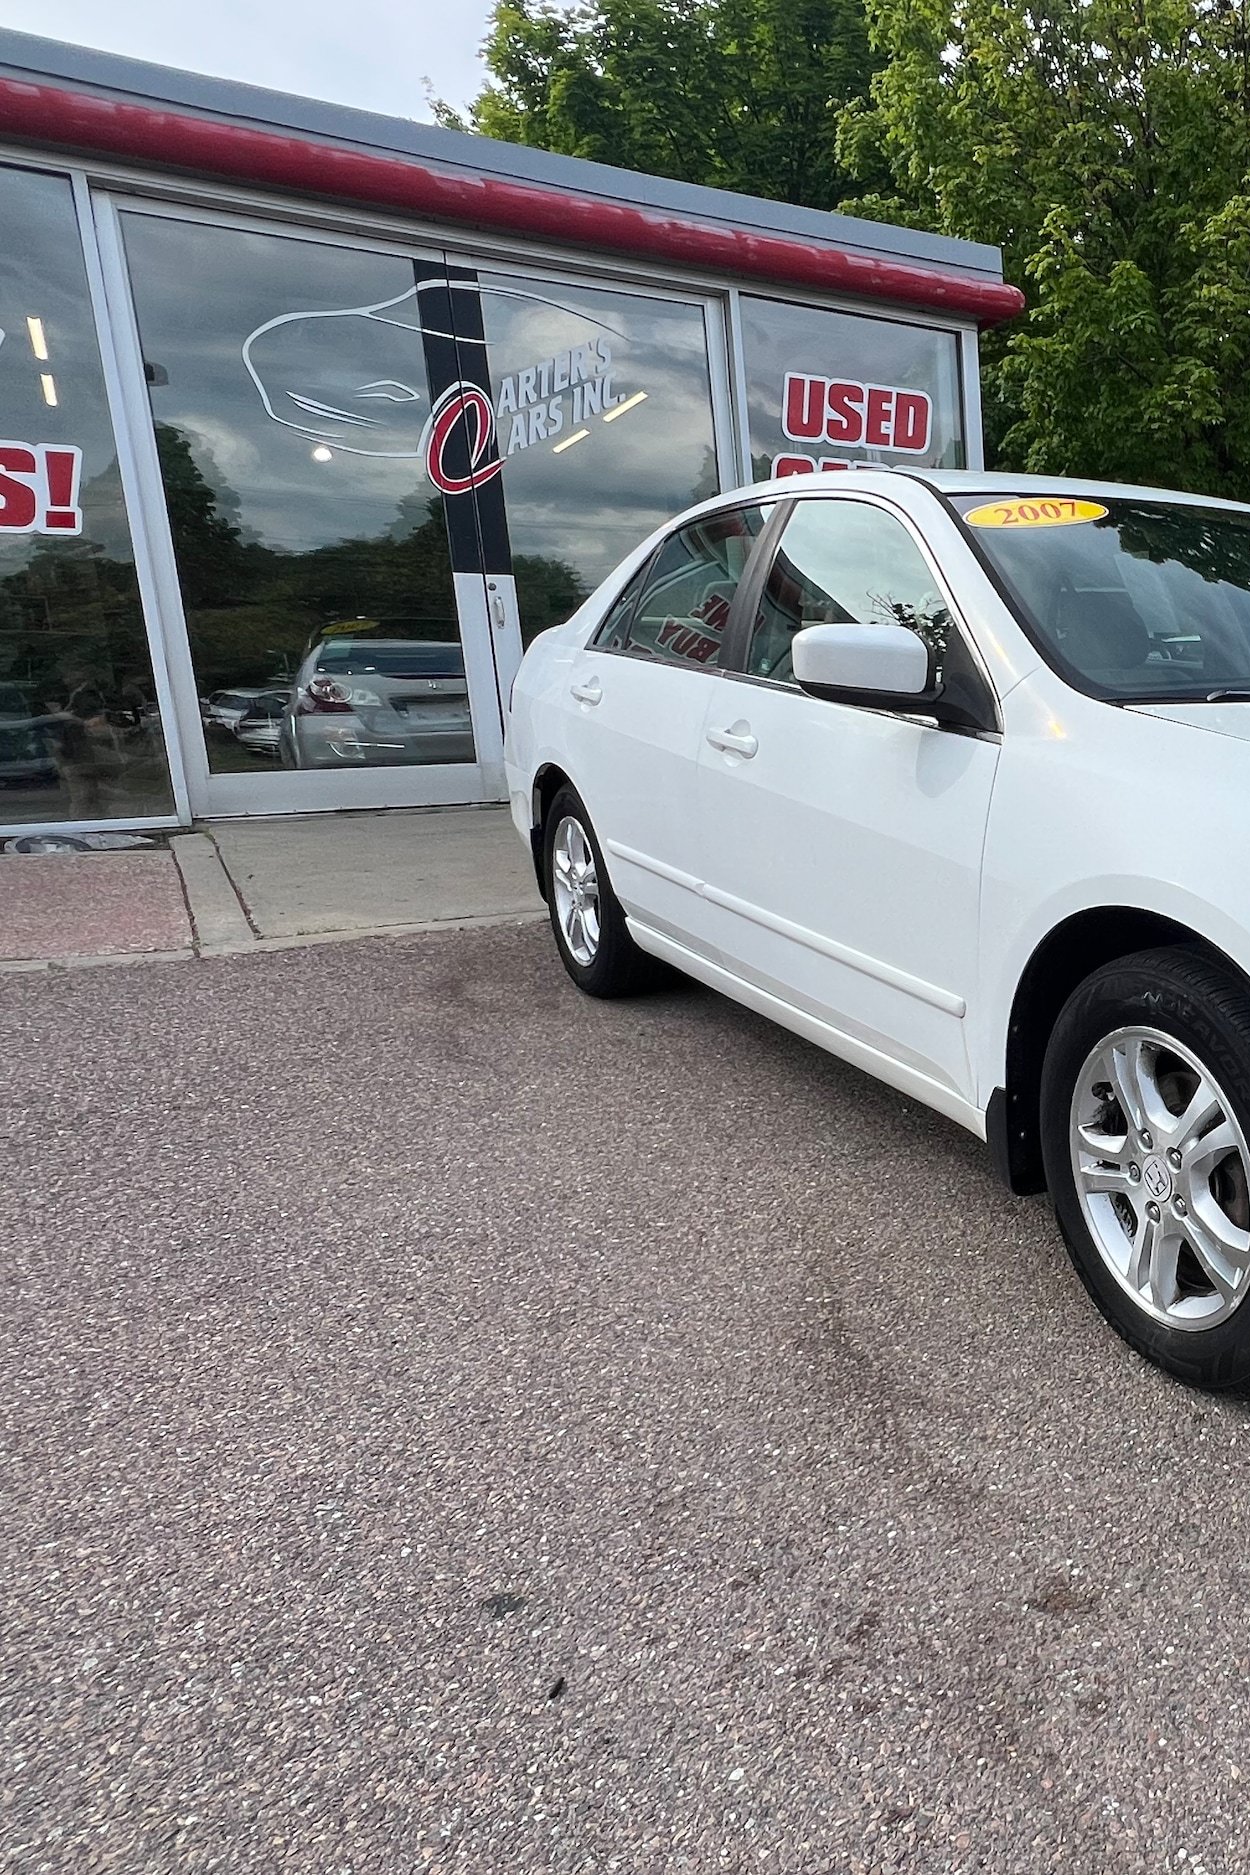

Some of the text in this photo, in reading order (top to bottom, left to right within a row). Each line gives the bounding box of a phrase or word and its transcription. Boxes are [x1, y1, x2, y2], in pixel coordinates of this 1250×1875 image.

[571, 373, 627, 425] INC.
[786, 377, 929, 450] USED
[994, 501, 1076, 525] 2007
